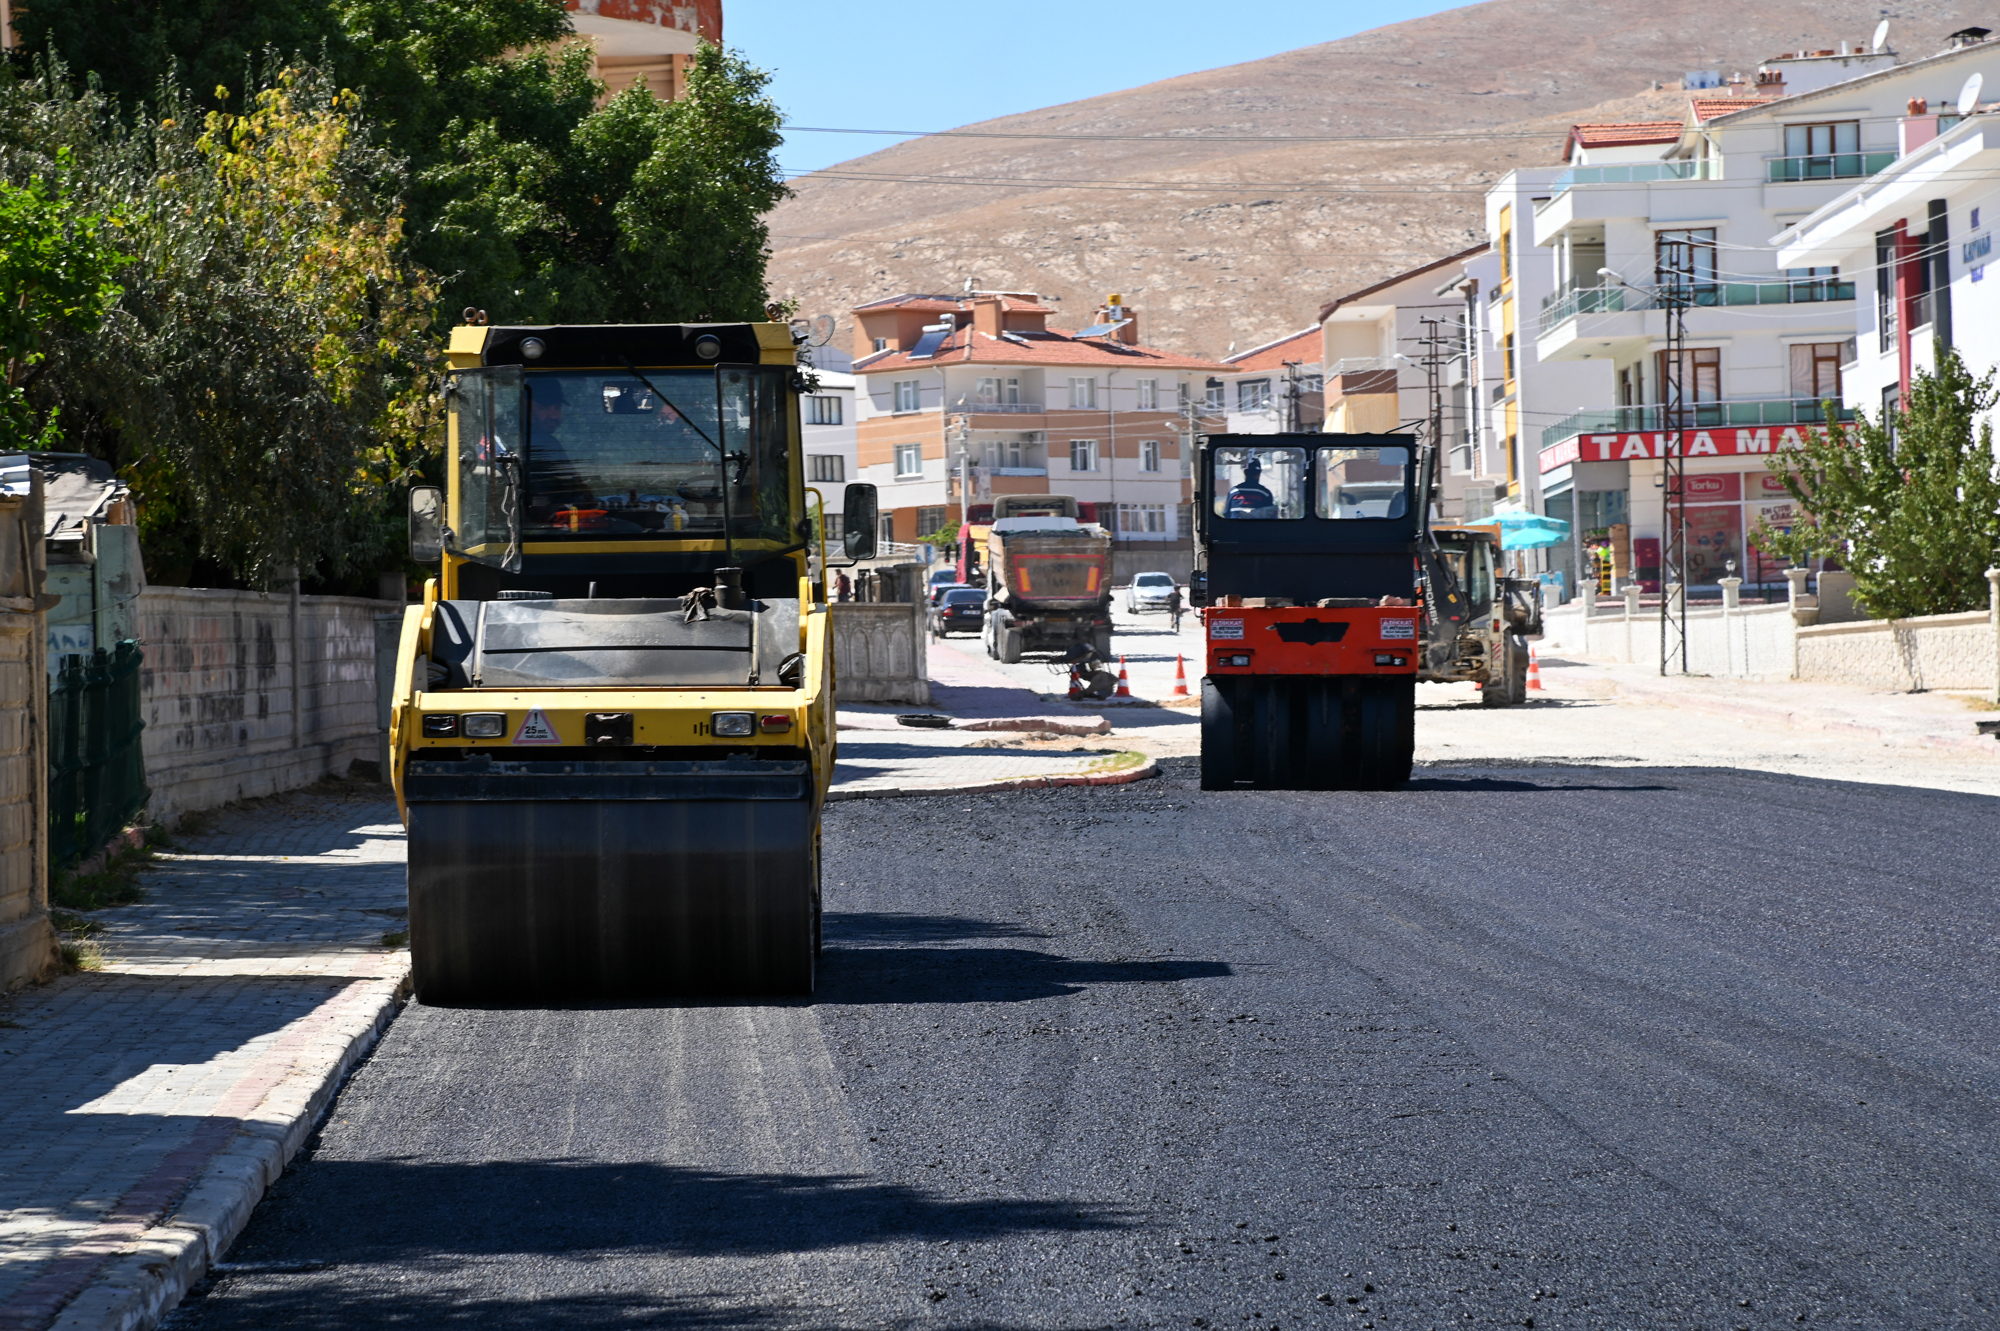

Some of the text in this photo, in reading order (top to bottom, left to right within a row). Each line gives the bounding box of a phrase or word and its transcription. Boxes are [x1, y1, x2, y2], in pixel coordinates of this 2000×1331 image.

[1591, 431, 1719, 460] TAHA
[1690, 480, 1720, 491] Torku
[525, 726, 537, 734] 25
